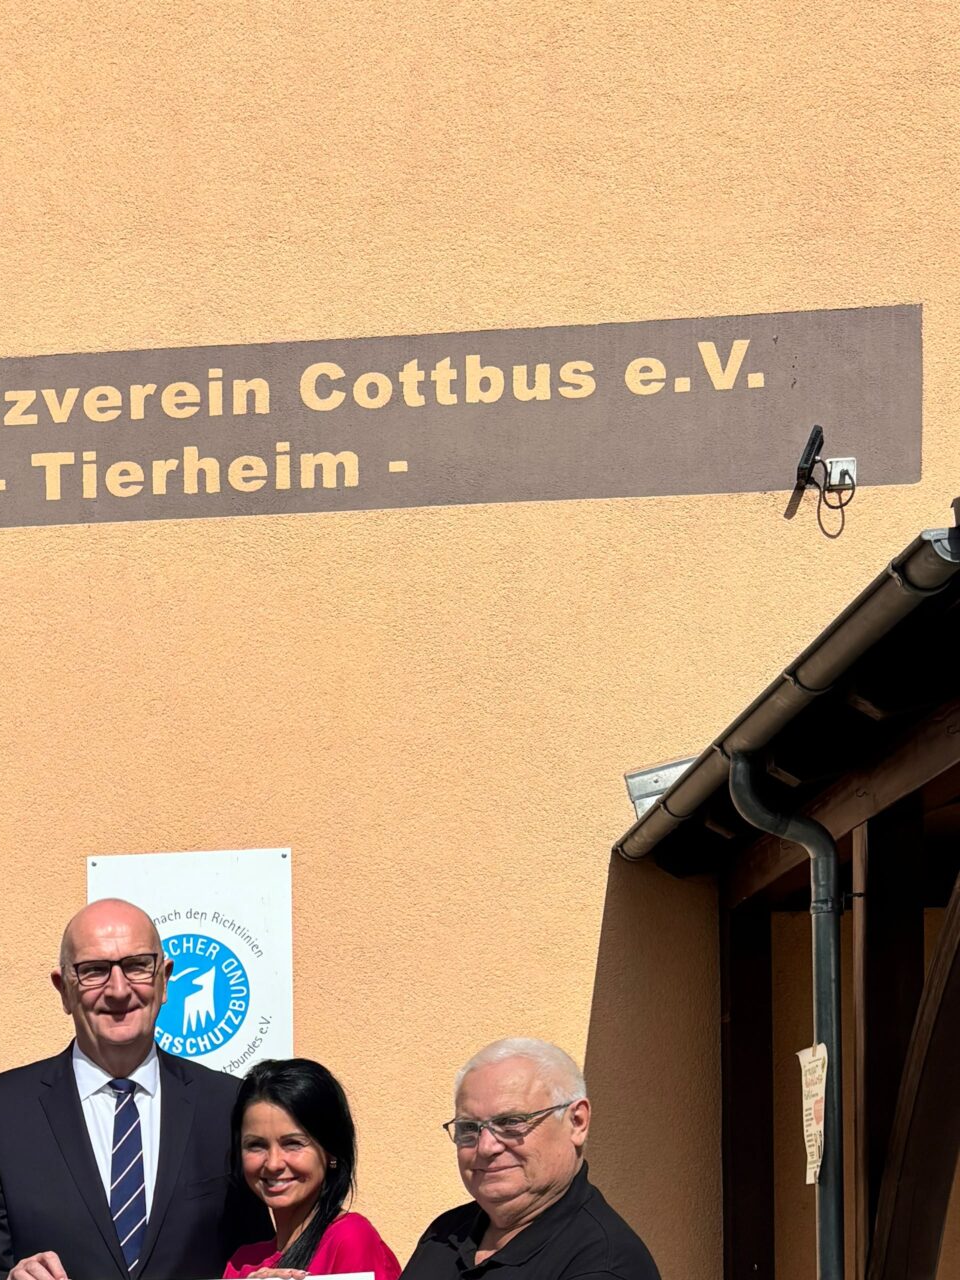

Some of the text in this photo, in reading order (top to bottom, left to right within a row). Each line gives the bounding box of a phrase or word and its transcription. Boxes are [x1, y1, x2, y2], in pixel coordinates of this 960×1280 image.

[299, 354, 597, 413] Cottbus
[625, 339, 765, 396] e.V.
[31, 441, 360, 501] Tierheim
[153, 908, 264, 958] nach den Richtlinien
[259, 1014, 273, 1036] e.V.
